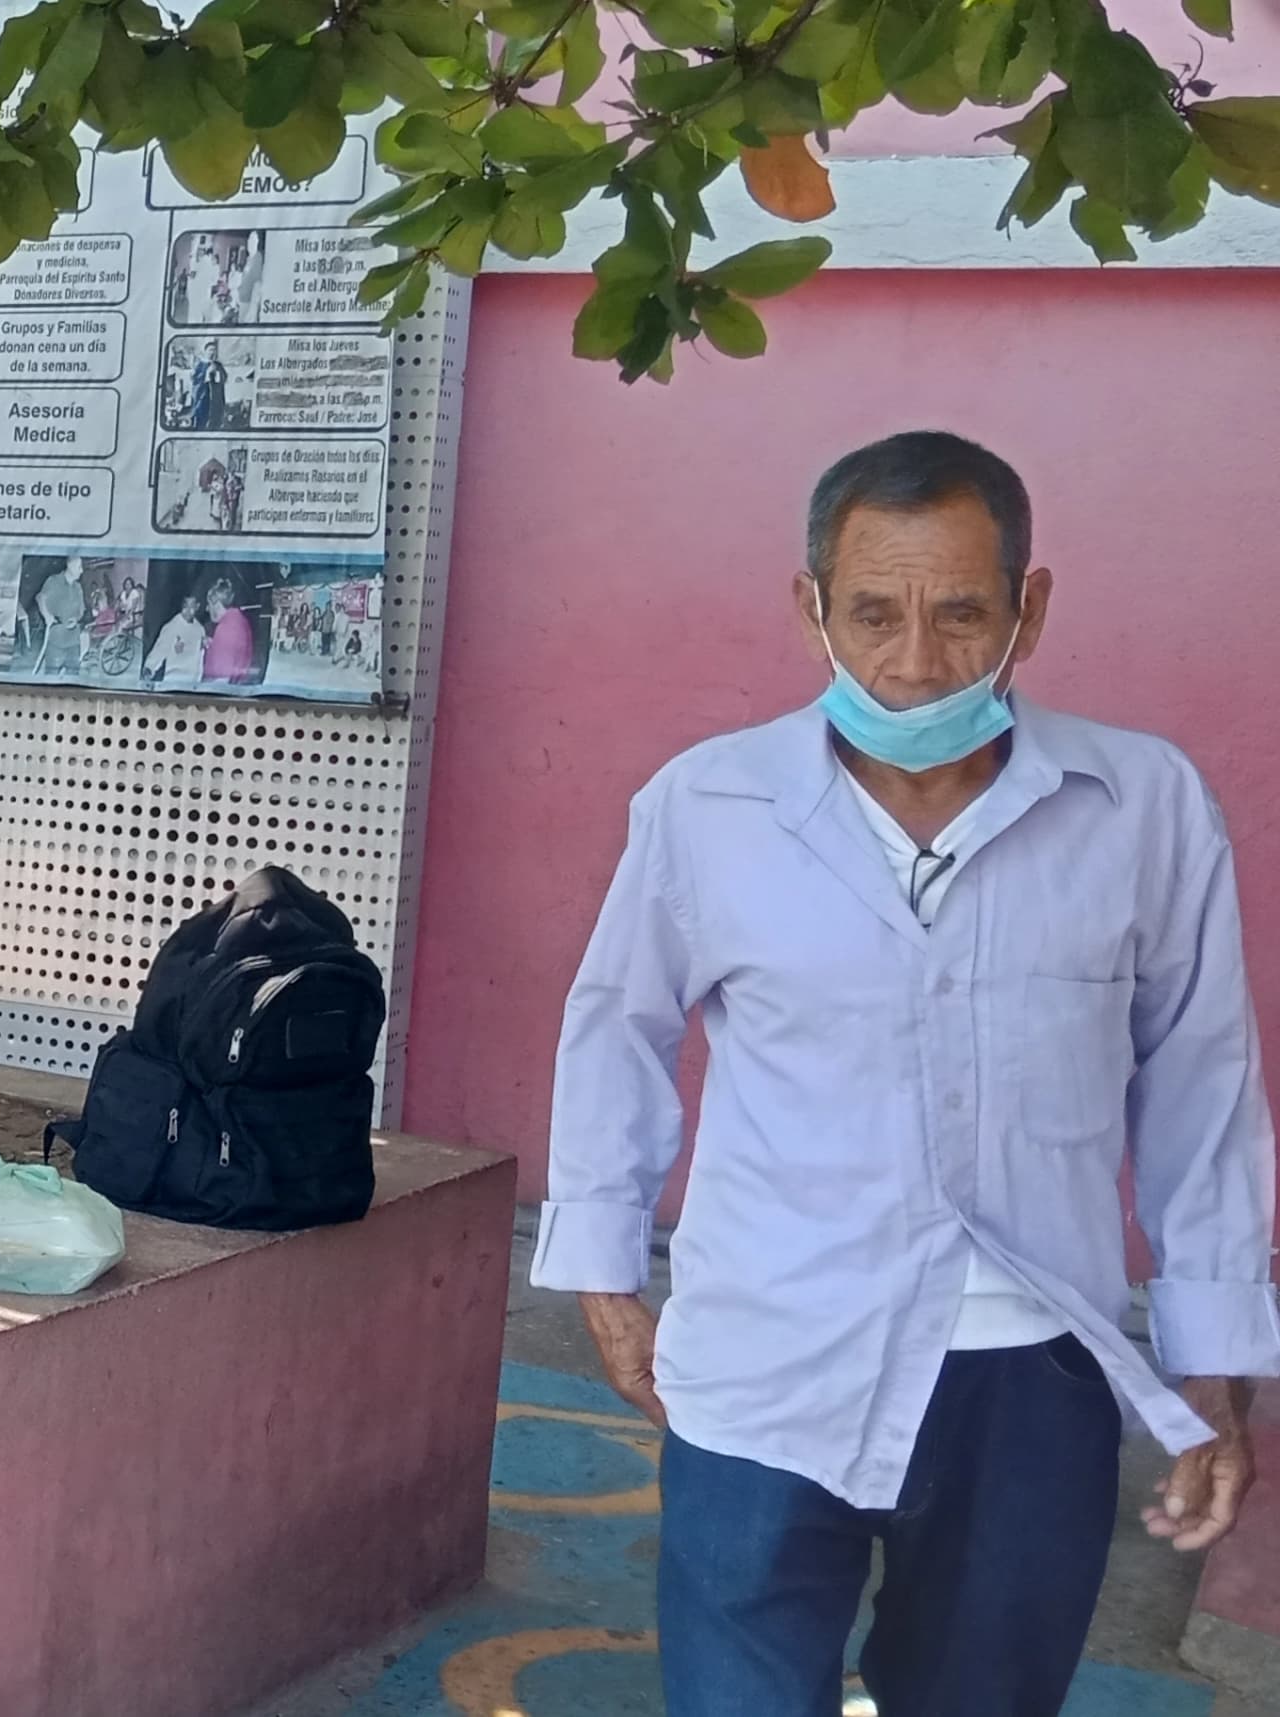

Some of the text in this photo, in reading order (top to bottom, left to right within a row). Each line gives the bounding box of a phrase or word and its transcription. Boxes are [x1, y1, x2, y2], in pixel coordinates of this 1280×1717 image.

[63, 239, 76, 251] de
[77, 239, 121, 253] despensa
[295, 239, 319, 253] Misa
[321, 239, 336, 252] los
[36, 259, 42, 270] y
[293, 261, 300, 273] a
[302, 259, 316, 273] las
[0, 272, 43, 288] Parroquia
[45, 271, 60, 284] del
[99, 270, 126, 284] Santo
[293, 279, 305, 293] En
[307, 278, 318, 292] el
[262, 300, 311, 314] Sacerdote
[313, 299, 347, 313] Arturo
[0, 319, 107, 337] Grupos y Familias
[37, 342, 67, 354] cena
[68, 342, 85, 354] un
[287, 338, 360, 352] Misa los Jueves
[9, 359, 91, 373] de la semana.
[7, 401, 85, 419] Asesoría
[13, 426, 77, 443] Medica
[250, 449, 279, 465] Grupos
[281, 449, 292, 463] de
[359, 469, 368, 483] el
[31, 479, 53, 497] de
[57, 481, 92, 502] tipo
